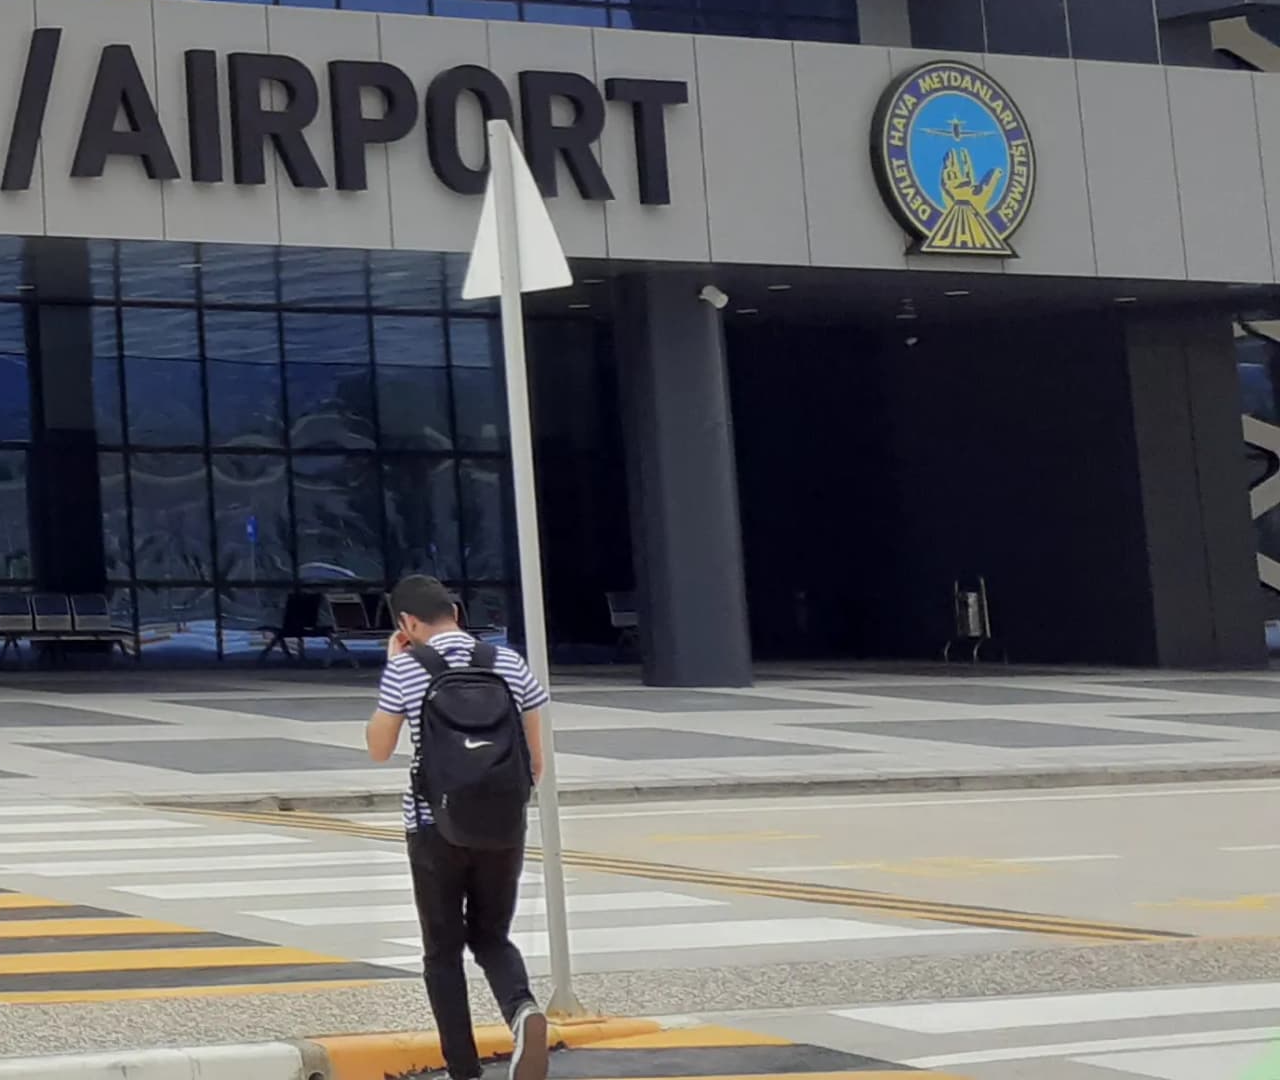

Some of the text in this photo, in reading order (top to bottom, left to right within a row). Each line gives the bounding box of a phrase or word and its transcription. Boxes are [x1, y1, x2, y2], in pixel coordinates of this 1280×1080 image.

[890, 93, 918, 146] HAVA
[918, 71, 1018, 131] MEYDANLARI
[892, 158, 932, 222] DEVLET
